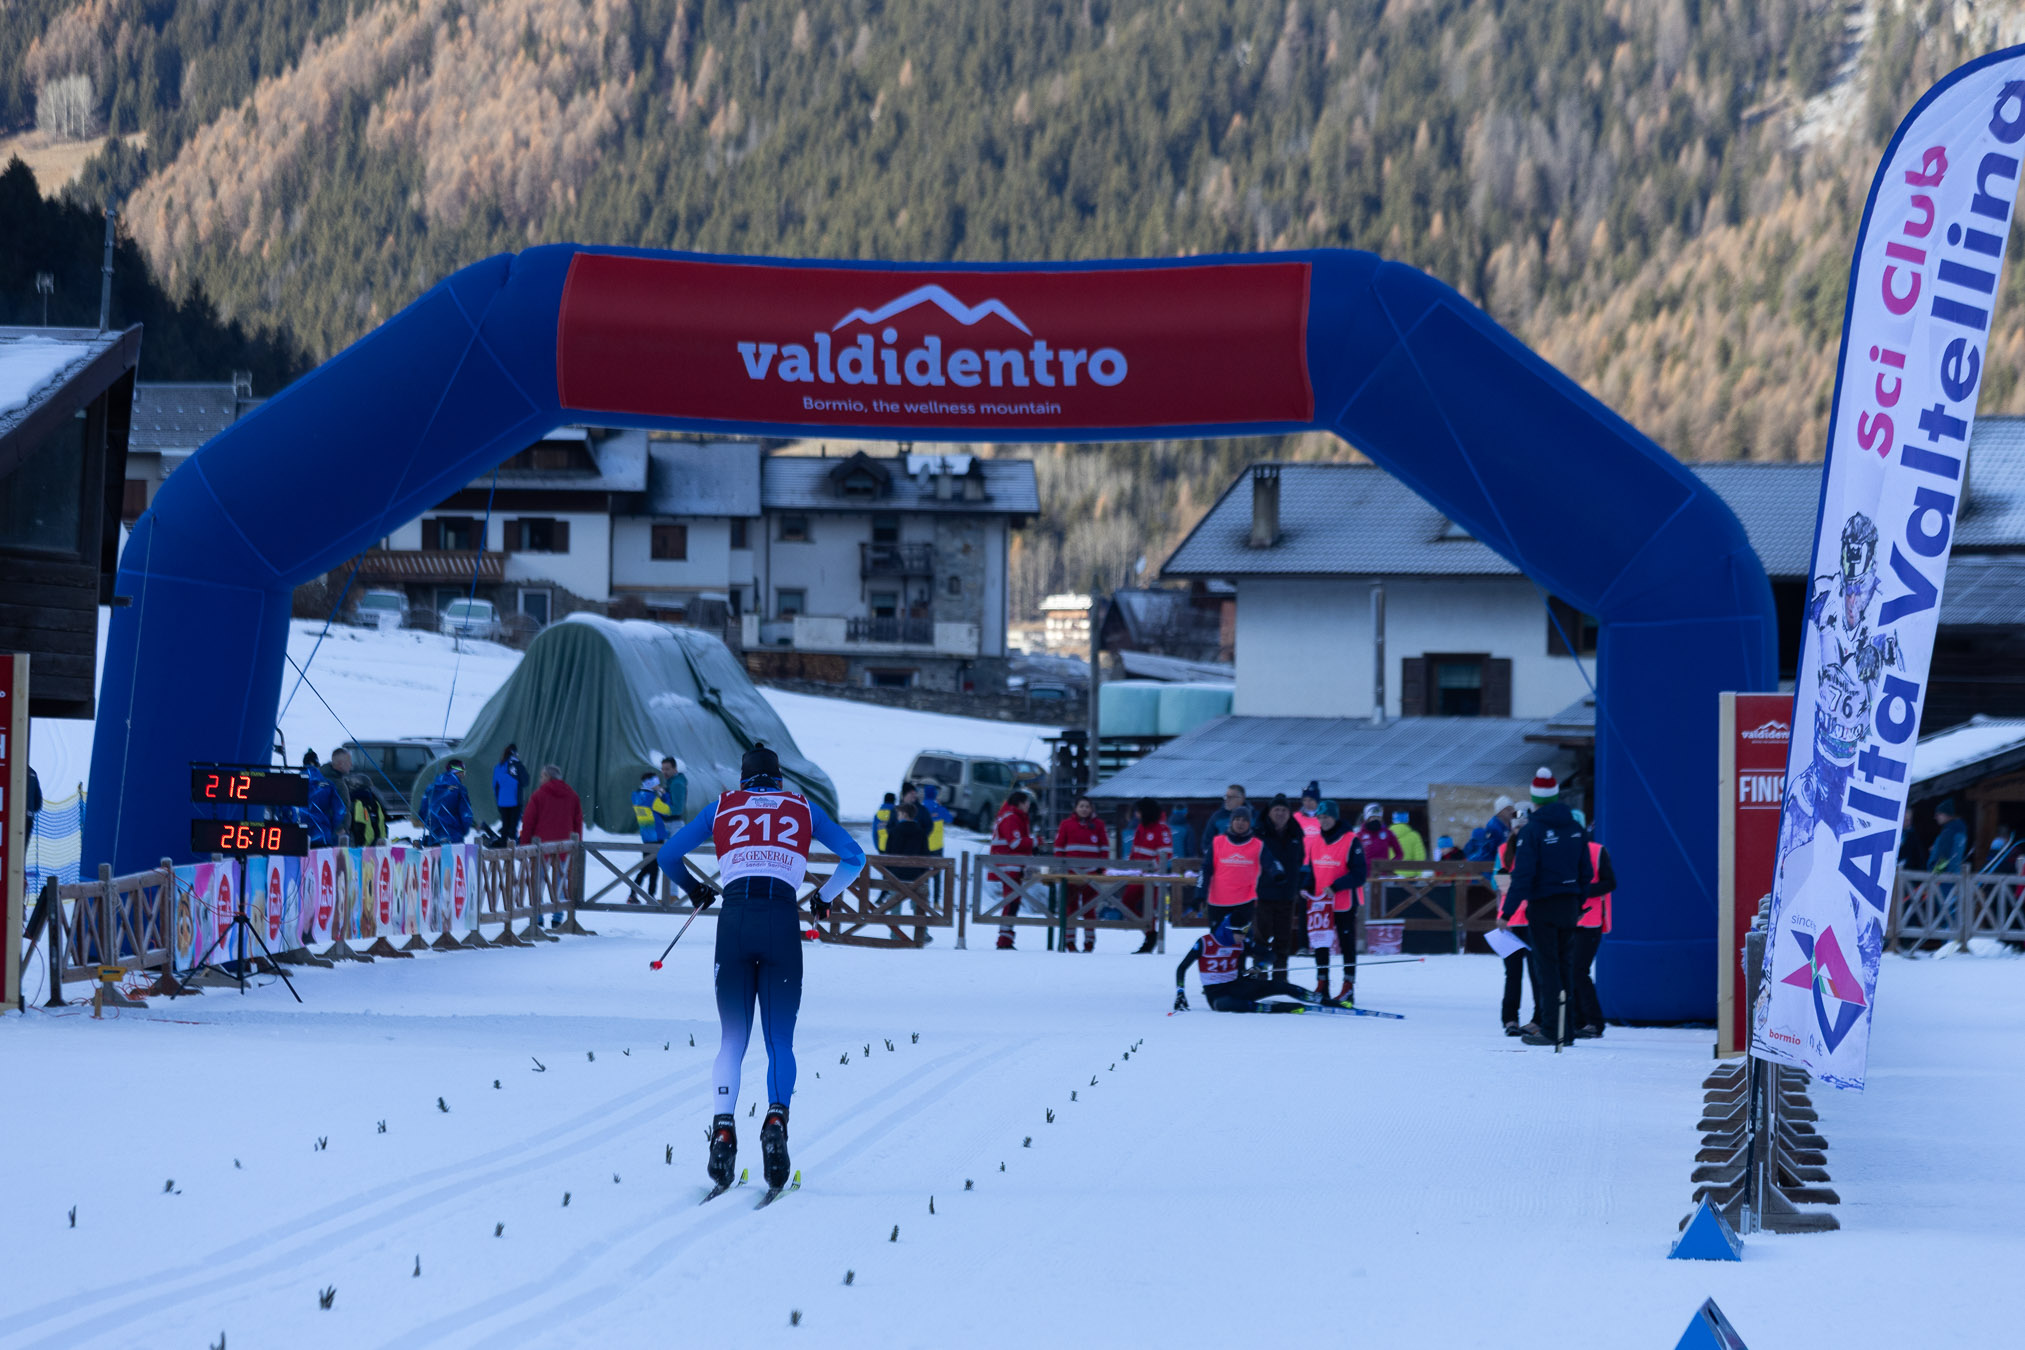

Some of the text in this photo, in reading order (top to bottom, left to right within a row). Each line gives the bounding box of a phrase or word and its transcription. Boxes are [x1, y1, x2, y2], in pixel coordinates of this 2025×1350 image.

[1856, 145, 1949, 459] Sci Club
[737, 327, 1129, 388] valdidentro
[802, 396, 1062, 415] Bormio, the wellness mountain
[1838, 79, 2025, 914] Alta Valtellina
[1828, 684, 1854, 719] 76
[204, 774, 252, 800] 212
[220, 825, 282, 851] 26:18
[728, 813, 800, 848] 212
[745, 850, 794, 866] GENERALI
[1207, 958, 1238, 972] 211
[1768, 1028, 1801, 1046] bormio
